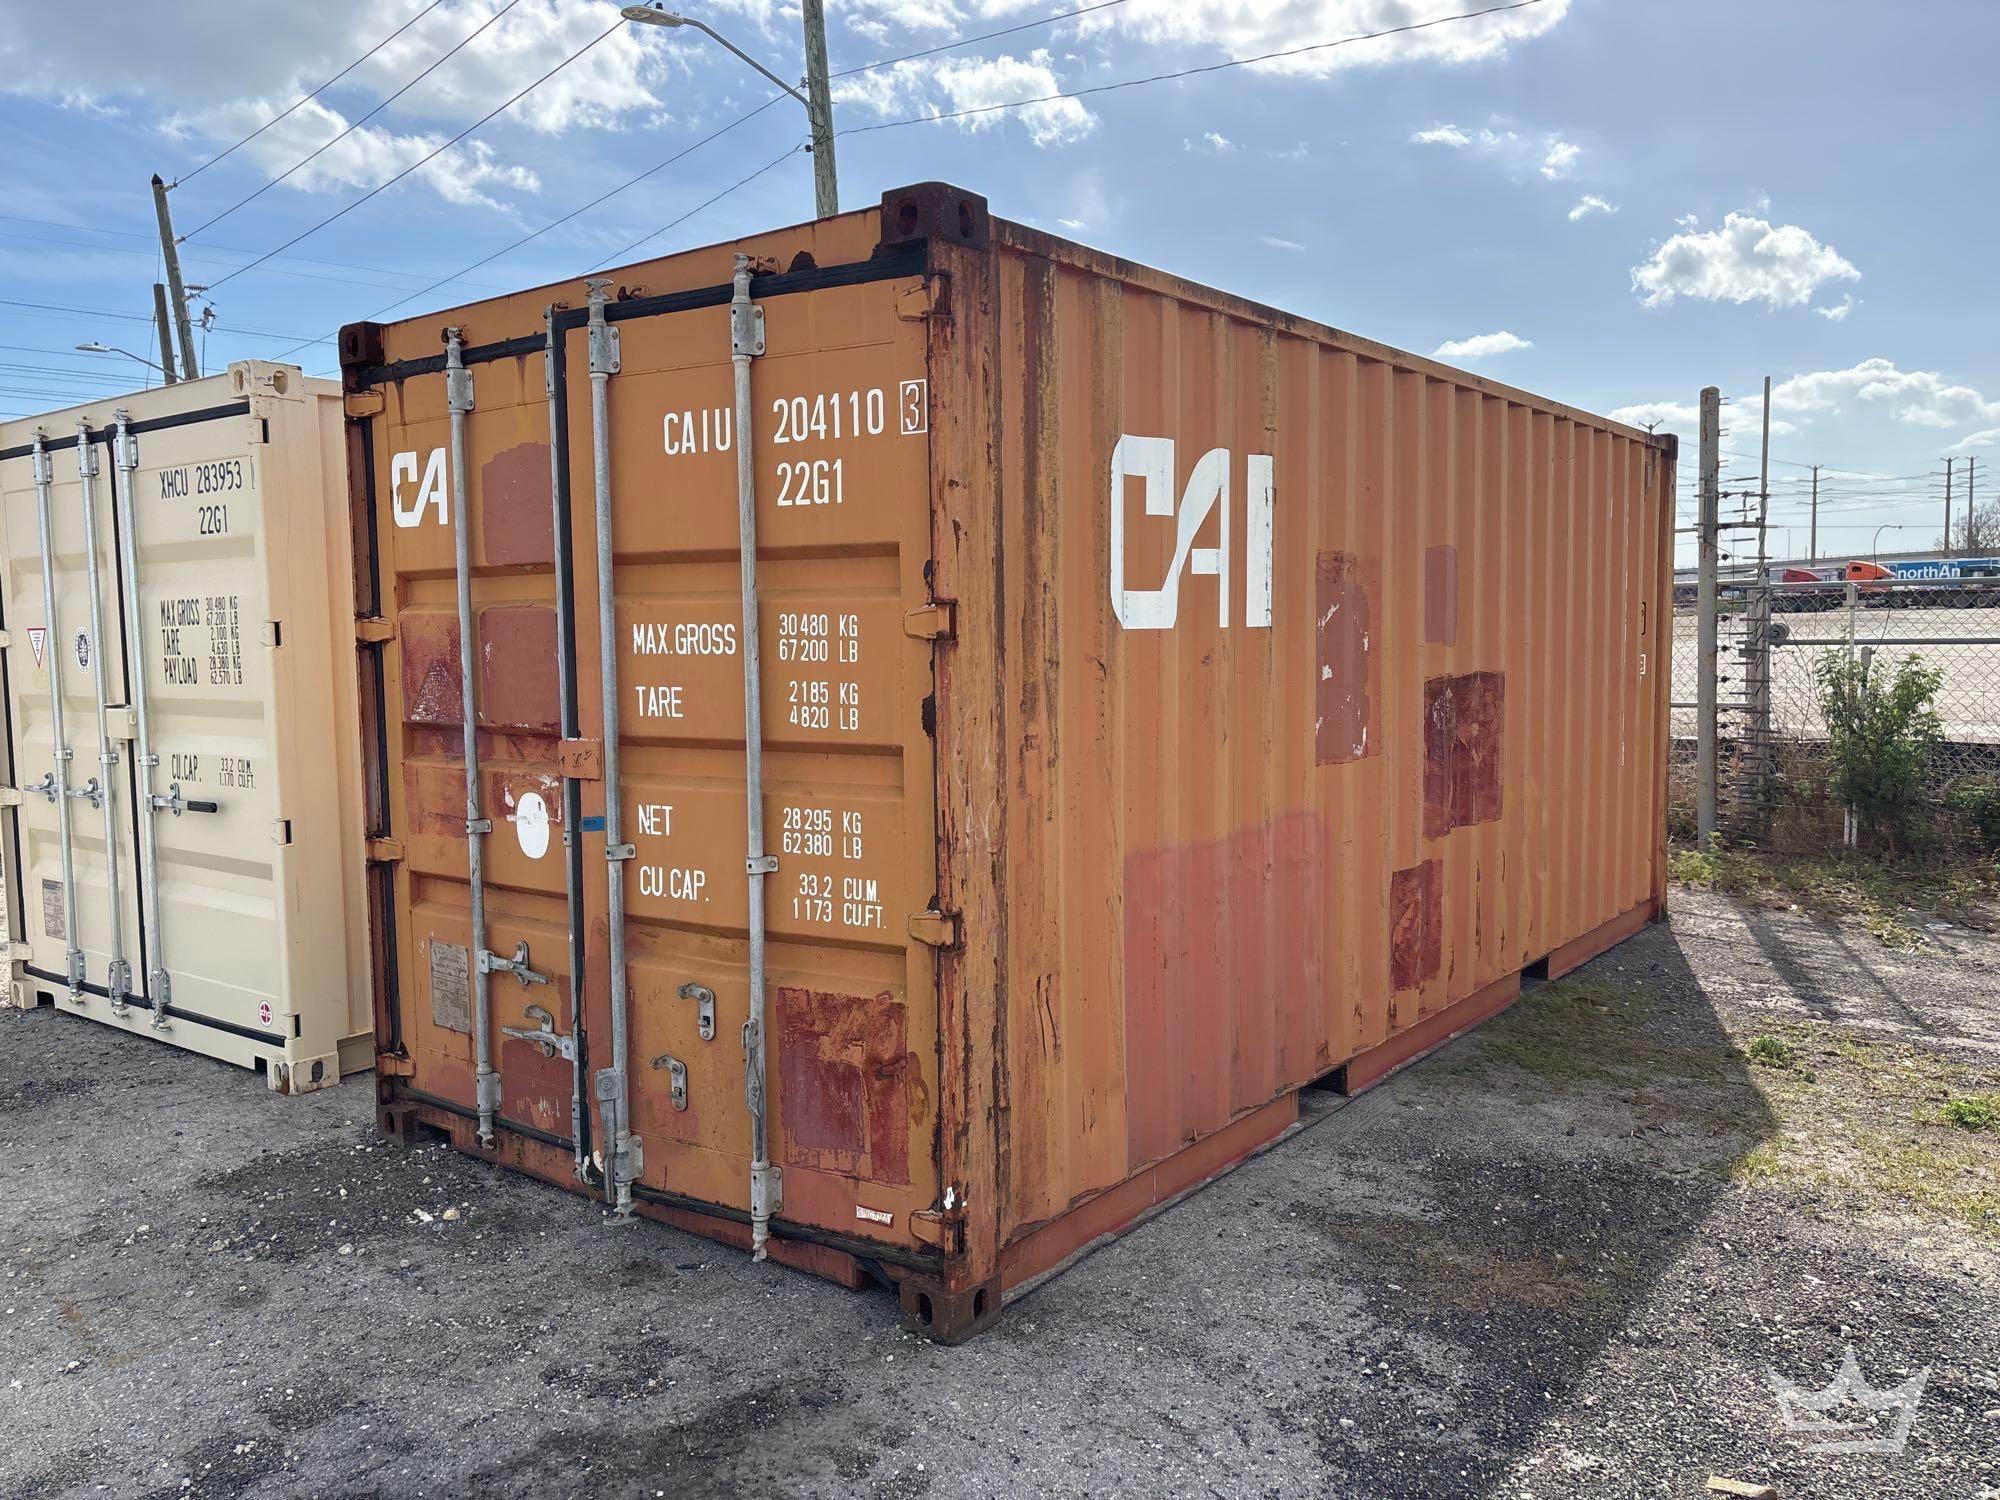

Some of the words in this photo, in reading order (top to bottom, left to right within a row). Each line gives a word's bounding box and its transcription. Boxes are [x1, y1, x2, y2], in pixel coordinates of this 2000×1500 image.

[664, 407, 731, 455] CAIU
[773, 388, 884, 443] 204110
[904, 383, 921, 432] 3
[159, 467, 188, 499] XHCU
[196, 460, 242, 494] 283953
[390, 446, 448, 528] CA
[776, 459, 843, 506] 22G1
[199, 504, 228, 534] 22G1
[1111, 434, 1273, 629] CAI
[176, 598, 200, 626] GROSS
[229, 595, 238, 610] KG
[230, 610, 239, 625] LB
[161, 628, 181, 655] TARE
[230, 625, 240, 640] KG
[231, 640, 241, 655] LB
[632, 623, 737, 655] MAX.GROSS
[839, 614, 858, 638] KG
[839, 639, 858, 663] LB
[164, 657, 198, 685] PAYLOAD
[232, 655, 242, 670] KG
[234, 670, 243, 685] LB
[635, 686, 684, 718] TARE
[789, 680, 829, 704] 2185
[839, 682, 859, 706] KG
[789, 705, 829, 729] 4820
[840, 707, 859, 731] LB
[638, 804, 673, 836] NET
[842, 811, 862, 835] KG
[843, 836, 862, 860] LB
[639, 865, 710, 902] CU.CAP.
[799, 873, 833, 899] 33.2
[793, 897, 833, 923] 1173
